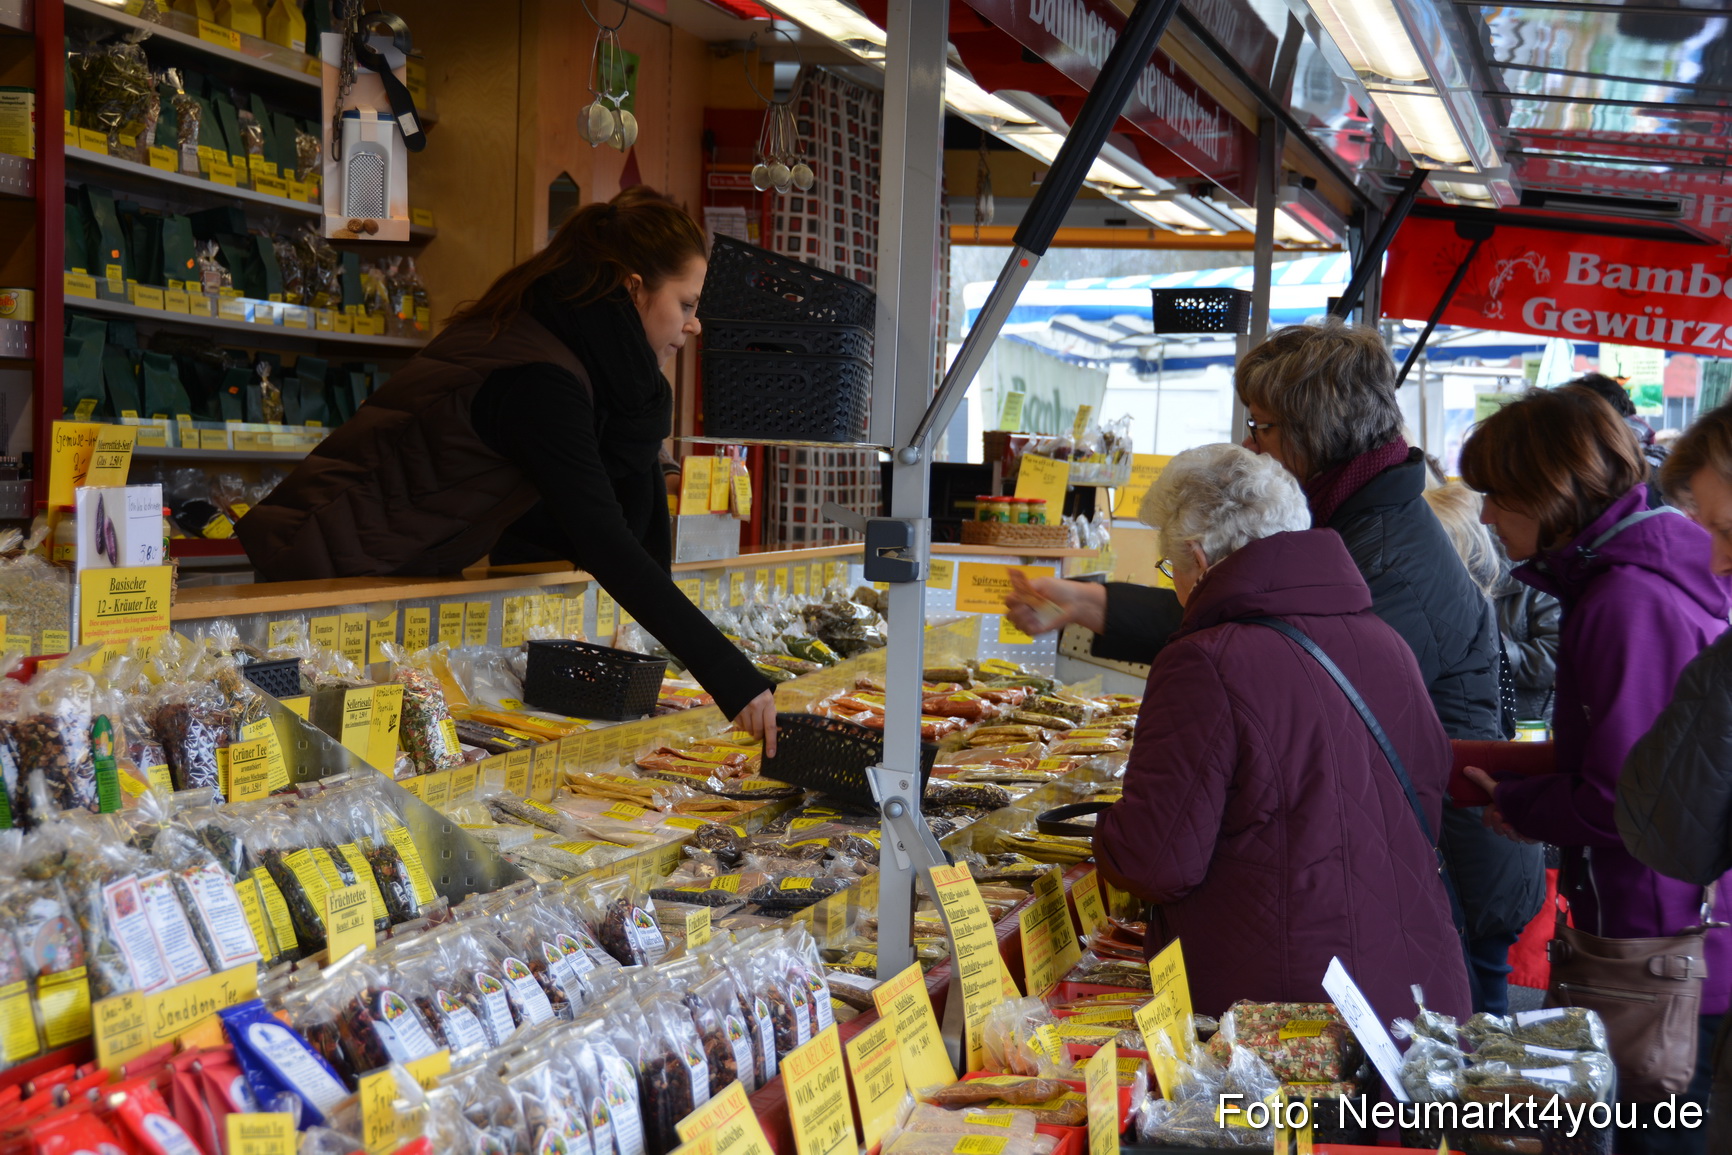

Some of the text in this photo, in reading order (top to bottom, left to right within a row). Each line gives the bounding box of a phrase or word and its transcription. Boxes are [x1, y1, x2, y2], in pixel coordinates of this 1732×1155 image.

[110, 577, 146, 591] Basischer
[97, 600, 107, 613] 12
[114, 599, 143, 612] Kräuter
[145, 597, 157, 610] Tee
[344, 622, 363, 633] Paprika
[347, 698, 372, 710] Selleriesalz
[233, 744, 267, 761] Grüner Tee
[330, 888, 367, 911] Früchtetee
[336, 922, 349, 931] Beutel
[913, 1003, 929, 1021] Einlegen
[856, 1027, 887, 1056] Saucenkräuter
[795, 1080, 815, 1107] WOK
[818, 1065, 841, 1093] Gewürz
